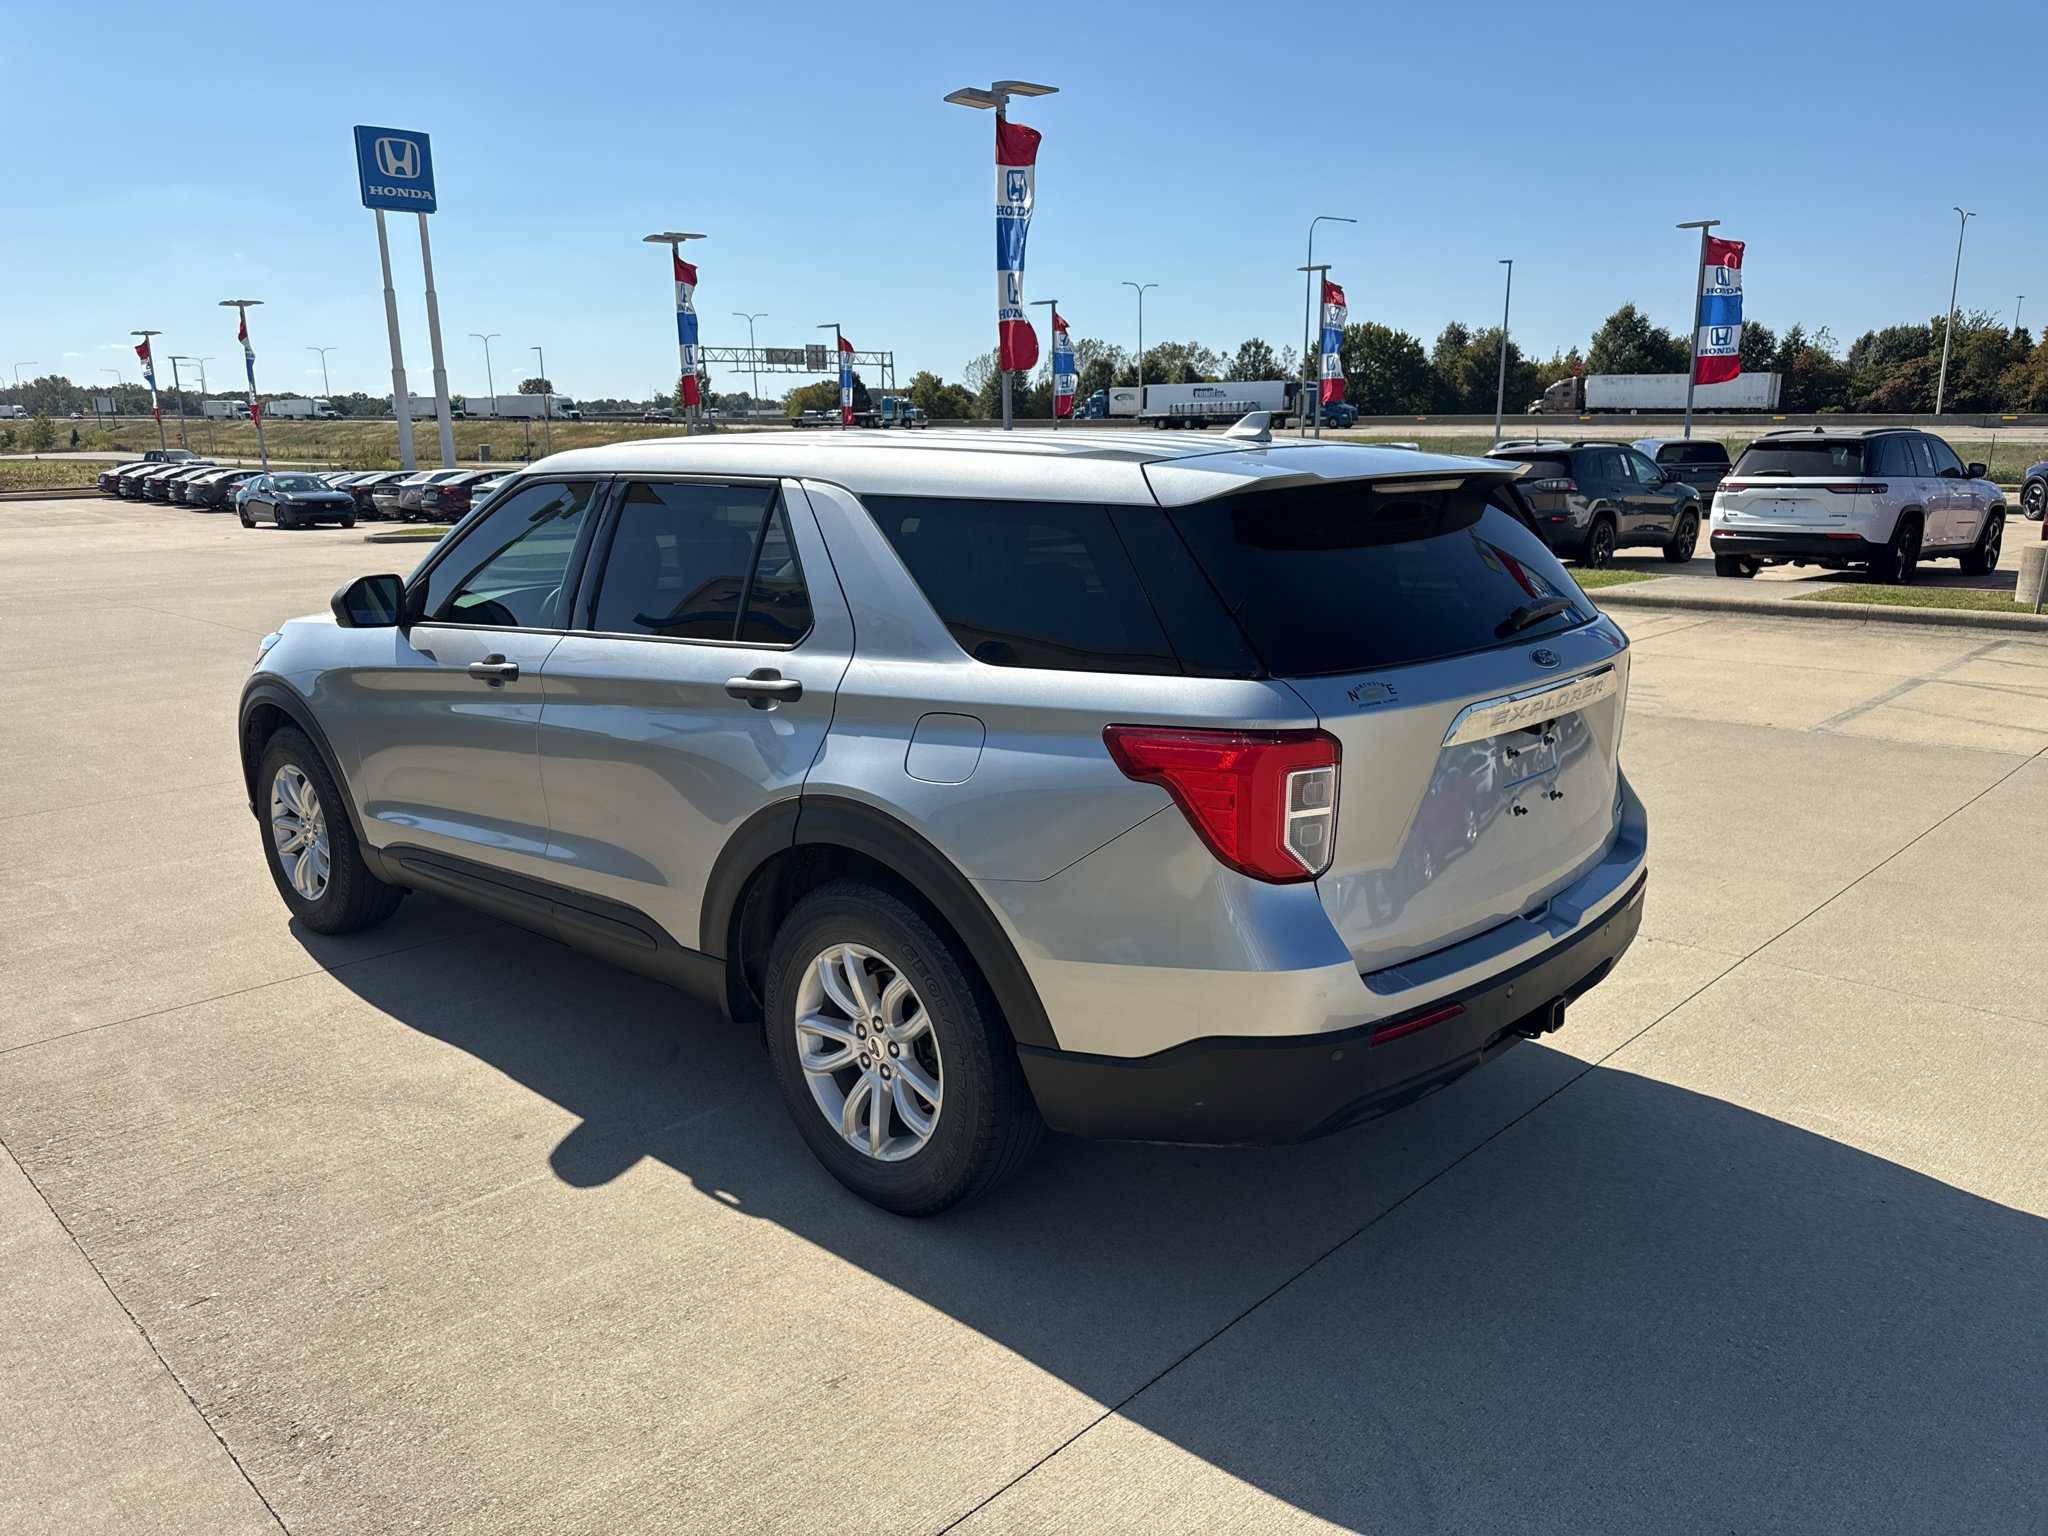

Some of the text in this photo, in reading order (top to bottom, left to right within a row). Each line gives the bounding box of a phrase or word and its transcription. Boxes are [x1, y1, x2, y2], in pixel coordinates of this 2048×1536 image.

[368, 185, 434, 200] HONDA
[1700, 346, 1737, 355] HONDA
[1347, 681, 1398, 701] NORTHSIDE
[1489, 680, 1604, 727] EXPLORER
